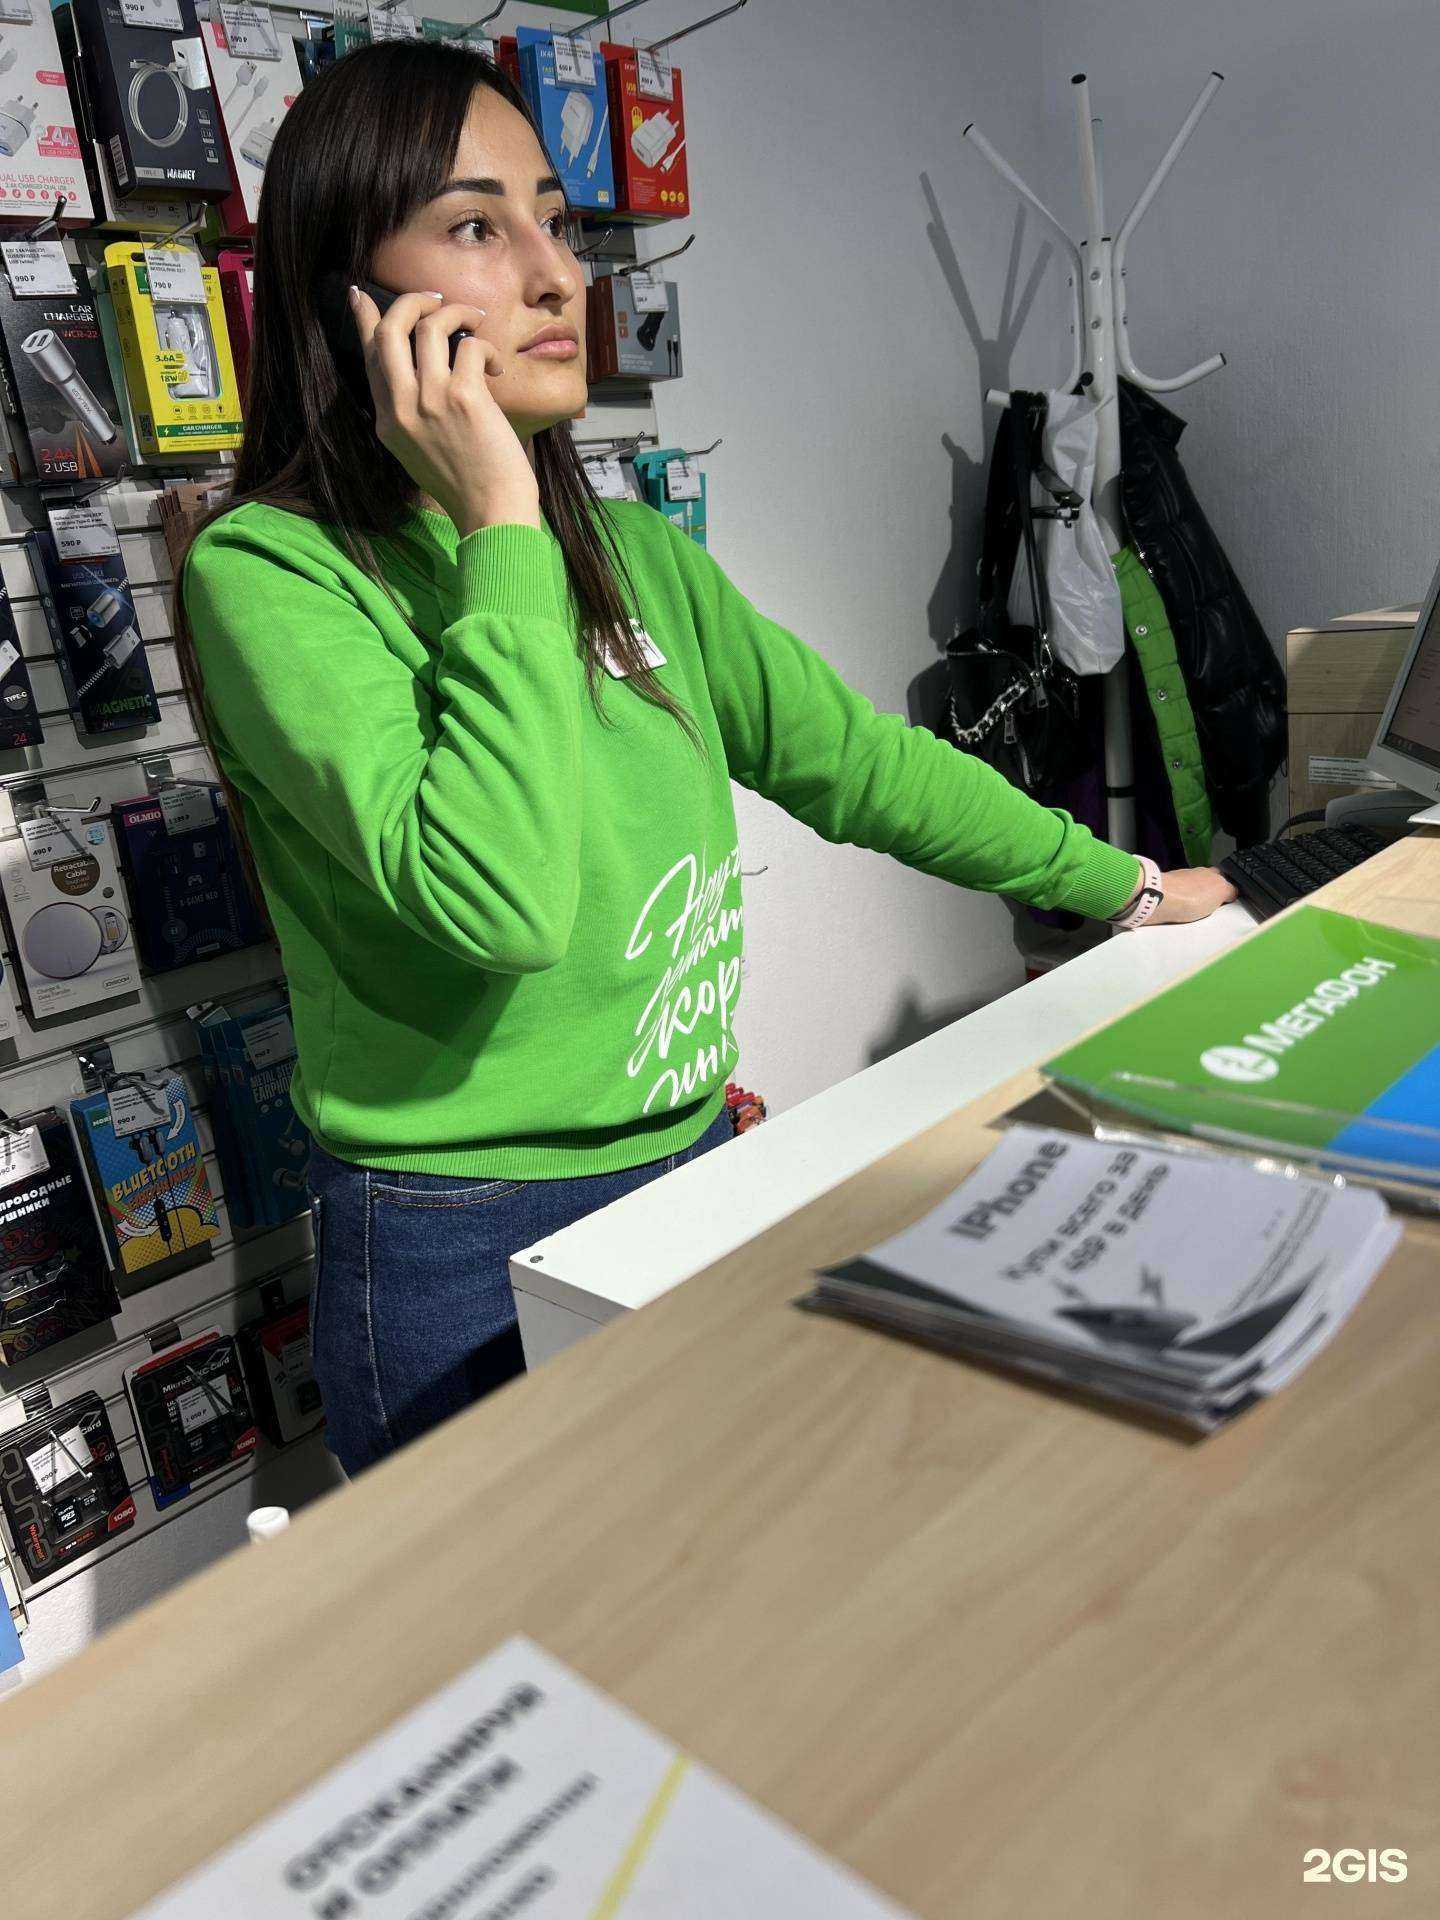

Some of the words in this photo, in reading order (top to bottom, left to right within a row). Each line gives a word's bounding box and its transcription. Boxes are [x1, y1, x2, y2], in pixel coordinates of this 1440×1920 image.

[70, 305, 92, 313] CAR
[44, 312, 94, 322] CHARGER
[44, 463, 51, 473] 2
[54, 461, 78, 472] USB
[4, 692, 28, 703] TYPE-C
[129, 811, 161, 825] OLMIO
[112, 1142, 196, 1202] BLUETOOTH
